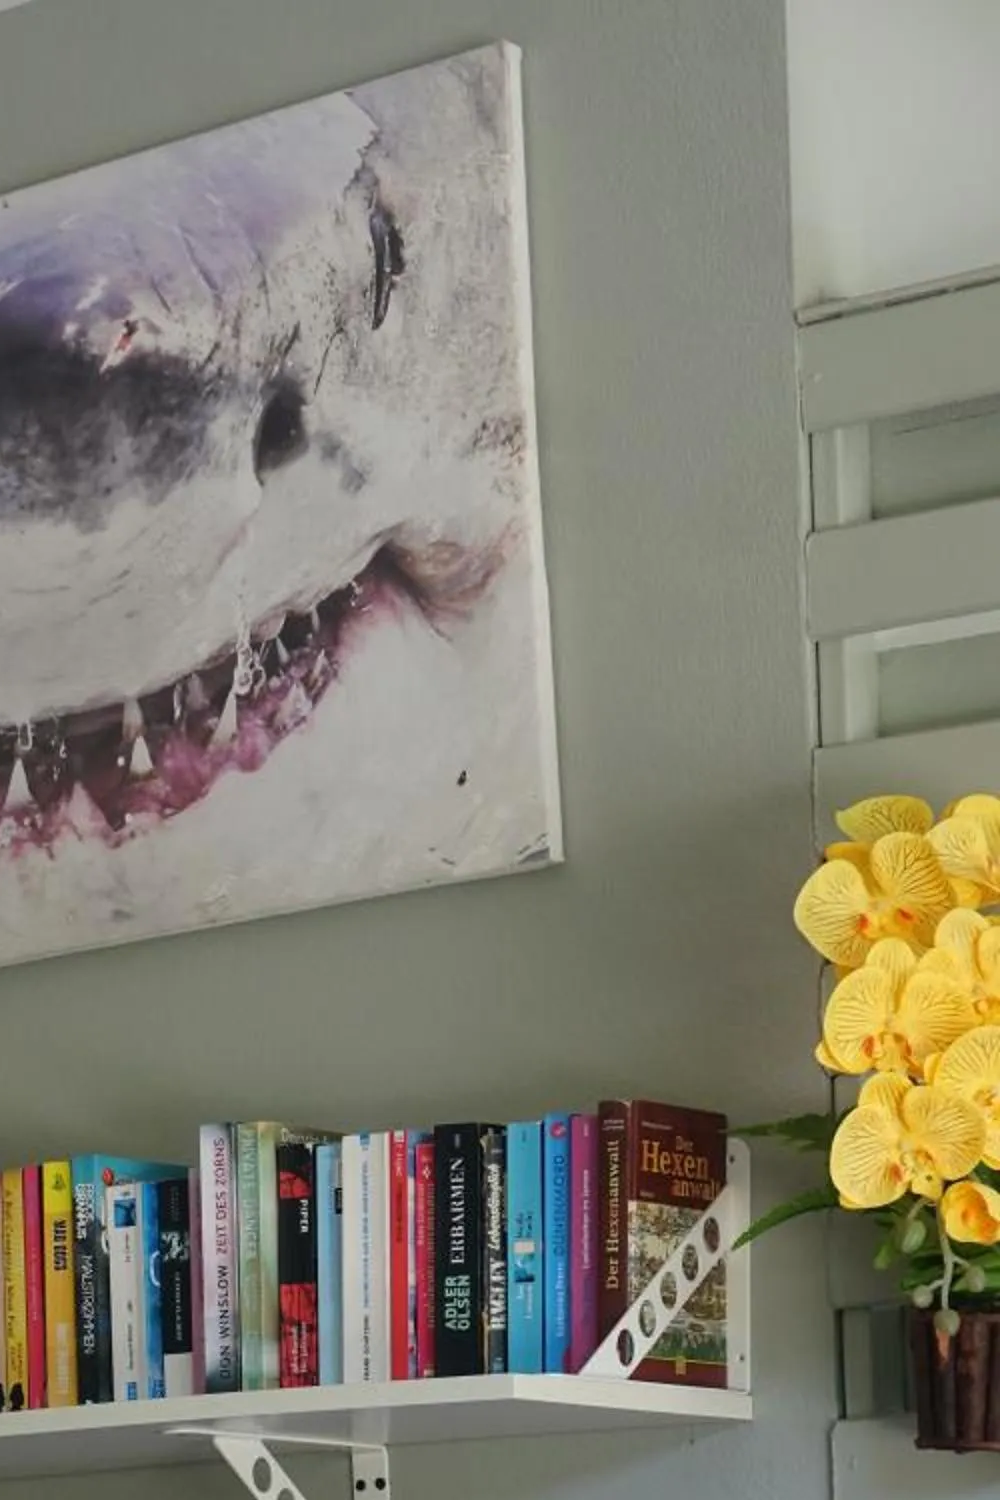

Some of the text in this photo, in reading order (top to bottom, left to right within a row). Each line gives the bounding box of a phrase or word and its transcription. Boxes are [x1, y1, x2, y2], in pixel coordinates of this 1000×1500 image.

[641, 1139, 709, 1180] Hexen
[676, 1136, 694, 1152] Der
[299, 1200, 309, 1233] PIPER
[449, 1157, 466, 1264] ERBARMEN
[213, 1138, 231, 1377] DON WINSLOW ZEIT DES ZORNS
[605, 1257, 619, 1290] Der
[444, 1275, 458, 1330] ADLER
[457, 1274, 471, 1331] OLSEN
